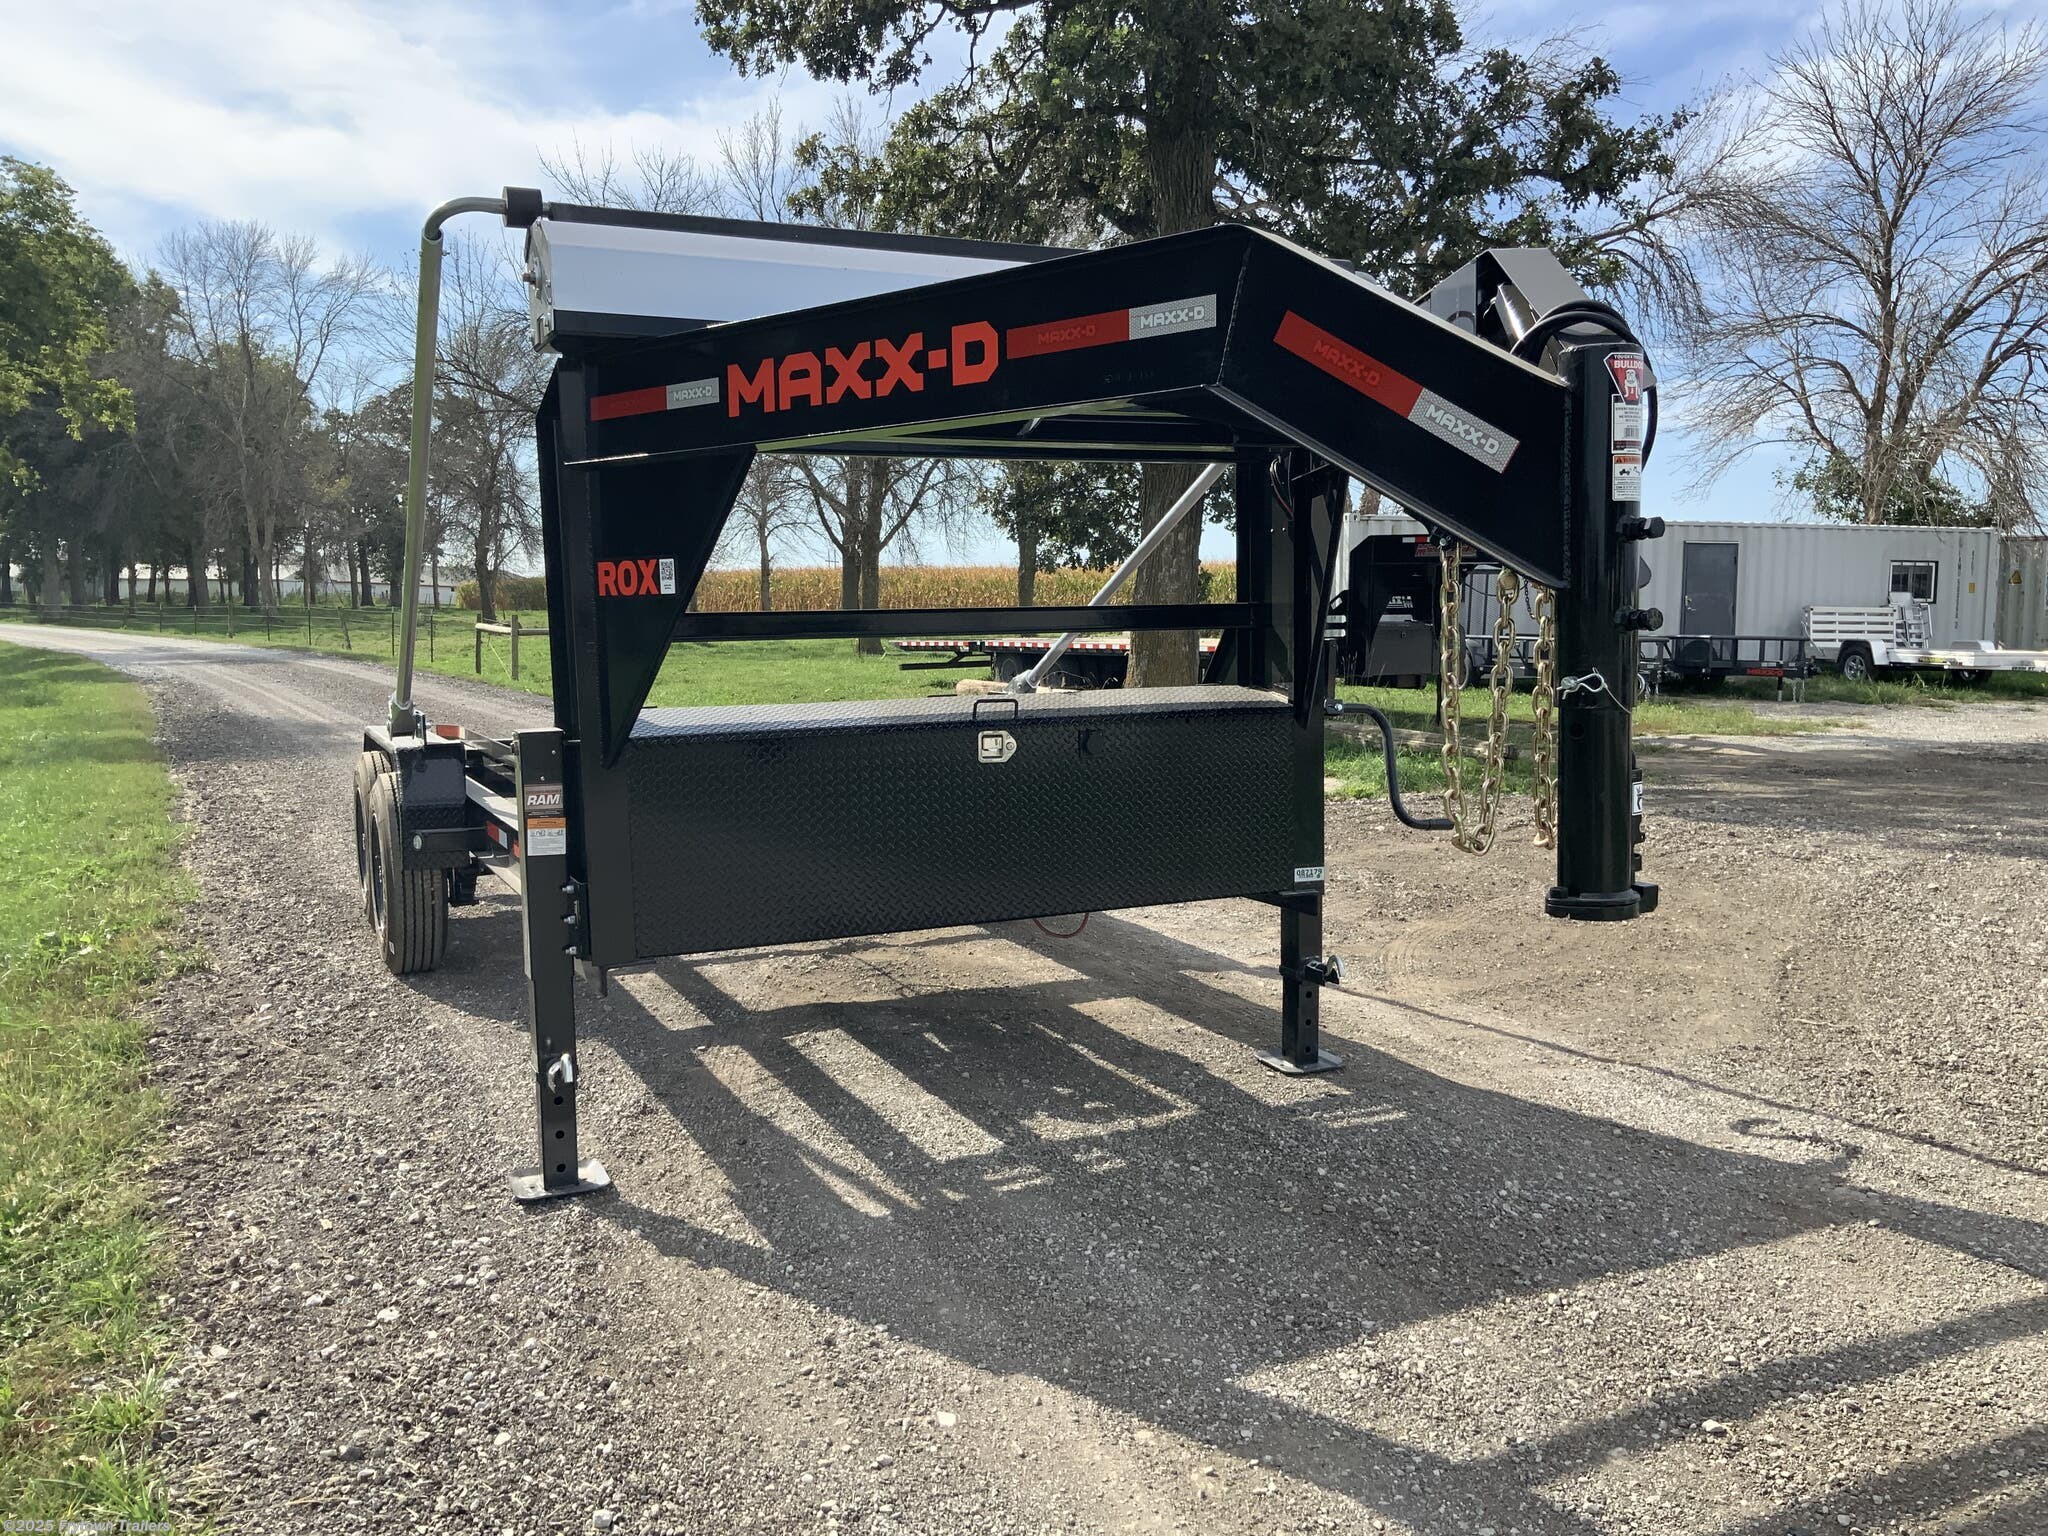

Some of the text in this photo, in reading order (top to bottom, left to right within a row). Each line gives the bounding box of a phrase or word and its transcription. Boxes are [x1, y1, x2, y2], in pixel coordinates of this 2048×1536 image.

[1140, 305, 1205, 329] MAXX-D
[1038, 325, 1095, 345] MAXX-D
[727, 320, 998, 418] MAXX-D
[1313, 340, 1381, 386] MAXX-D
[673, 386, 712, 401] MAXX-D
[1425, 404, 1500, 455] MAXX-D
[597, 558, 659, 596] ROX
[527, 794, 560, 806] RAM
